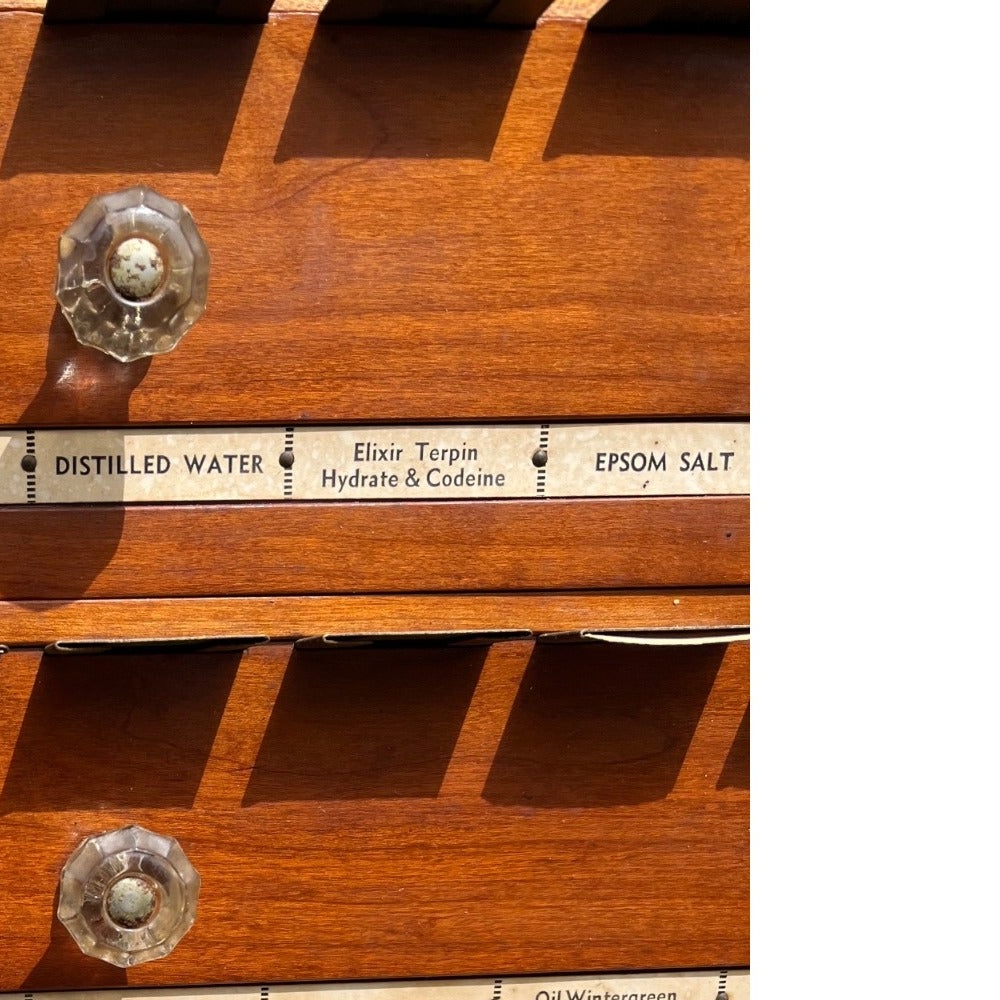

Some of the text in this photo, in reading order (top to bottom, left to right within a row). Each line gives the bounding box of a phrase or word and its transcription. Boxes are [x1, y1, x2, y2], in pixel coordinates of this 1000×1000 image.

[54, 453, 264, 476] DISTILLED WATER
[353, 441, 478, 465] Elixir Terpin
[594, 451, 735, 473] EPSOM SALT
[321, 467, 506, 491] Hydrate & Codeine
